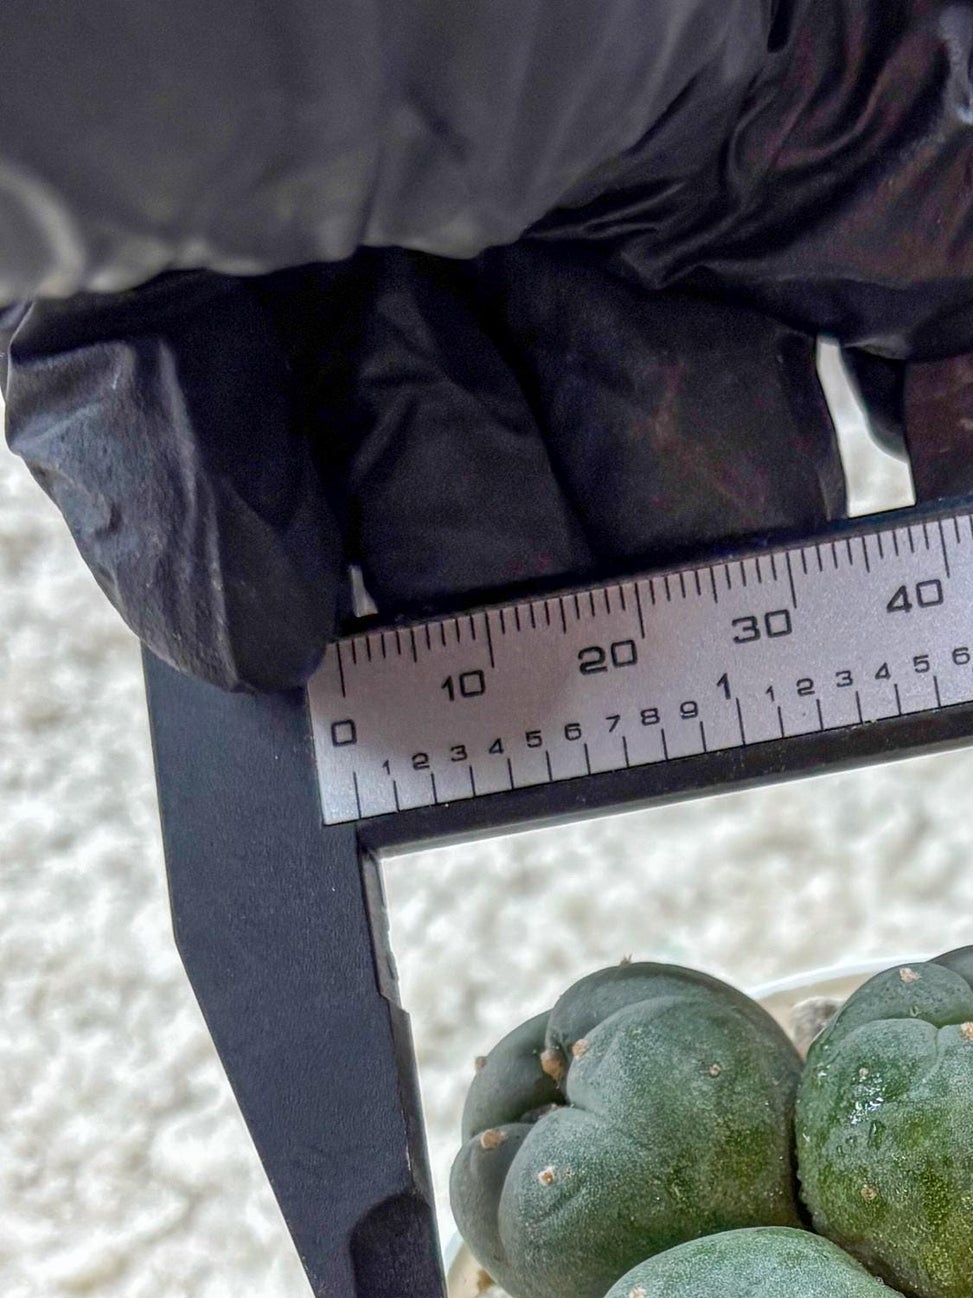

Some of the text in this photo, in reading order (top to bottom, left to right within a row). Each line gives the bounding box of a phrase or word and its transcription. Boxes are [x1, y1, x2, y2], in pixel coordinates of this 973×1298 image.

[441, 669, 485, 701] 10
[577, 639, 638, 675] 20
[731, 609, 793, 645] 30
[886, 579, 944, 614] 40
[331, 719, 357, 747] 0
[382, 760, 391, 775] 1
[411, 753, 432, 770] 2
[450, 745, 468, 762] 3
[488, 738, 505, 755] 4
[525, 730, 543, 748] 5
[565, 723, 582, 741] 6
[605, 714, 621, 733] 7
[640, 708, 661, 725] 8
[680, 701, 699, 719] 9
[717, 672, 731, 699] 1
[766, 685, 776, 702] 1
[796, 678, 815, 696] 2
[835, 670, 854, 688] 3
[874, 662, 892, 681] 4
[912, 655, 931, 673] 5
[951, 646, 971, 666] 6
